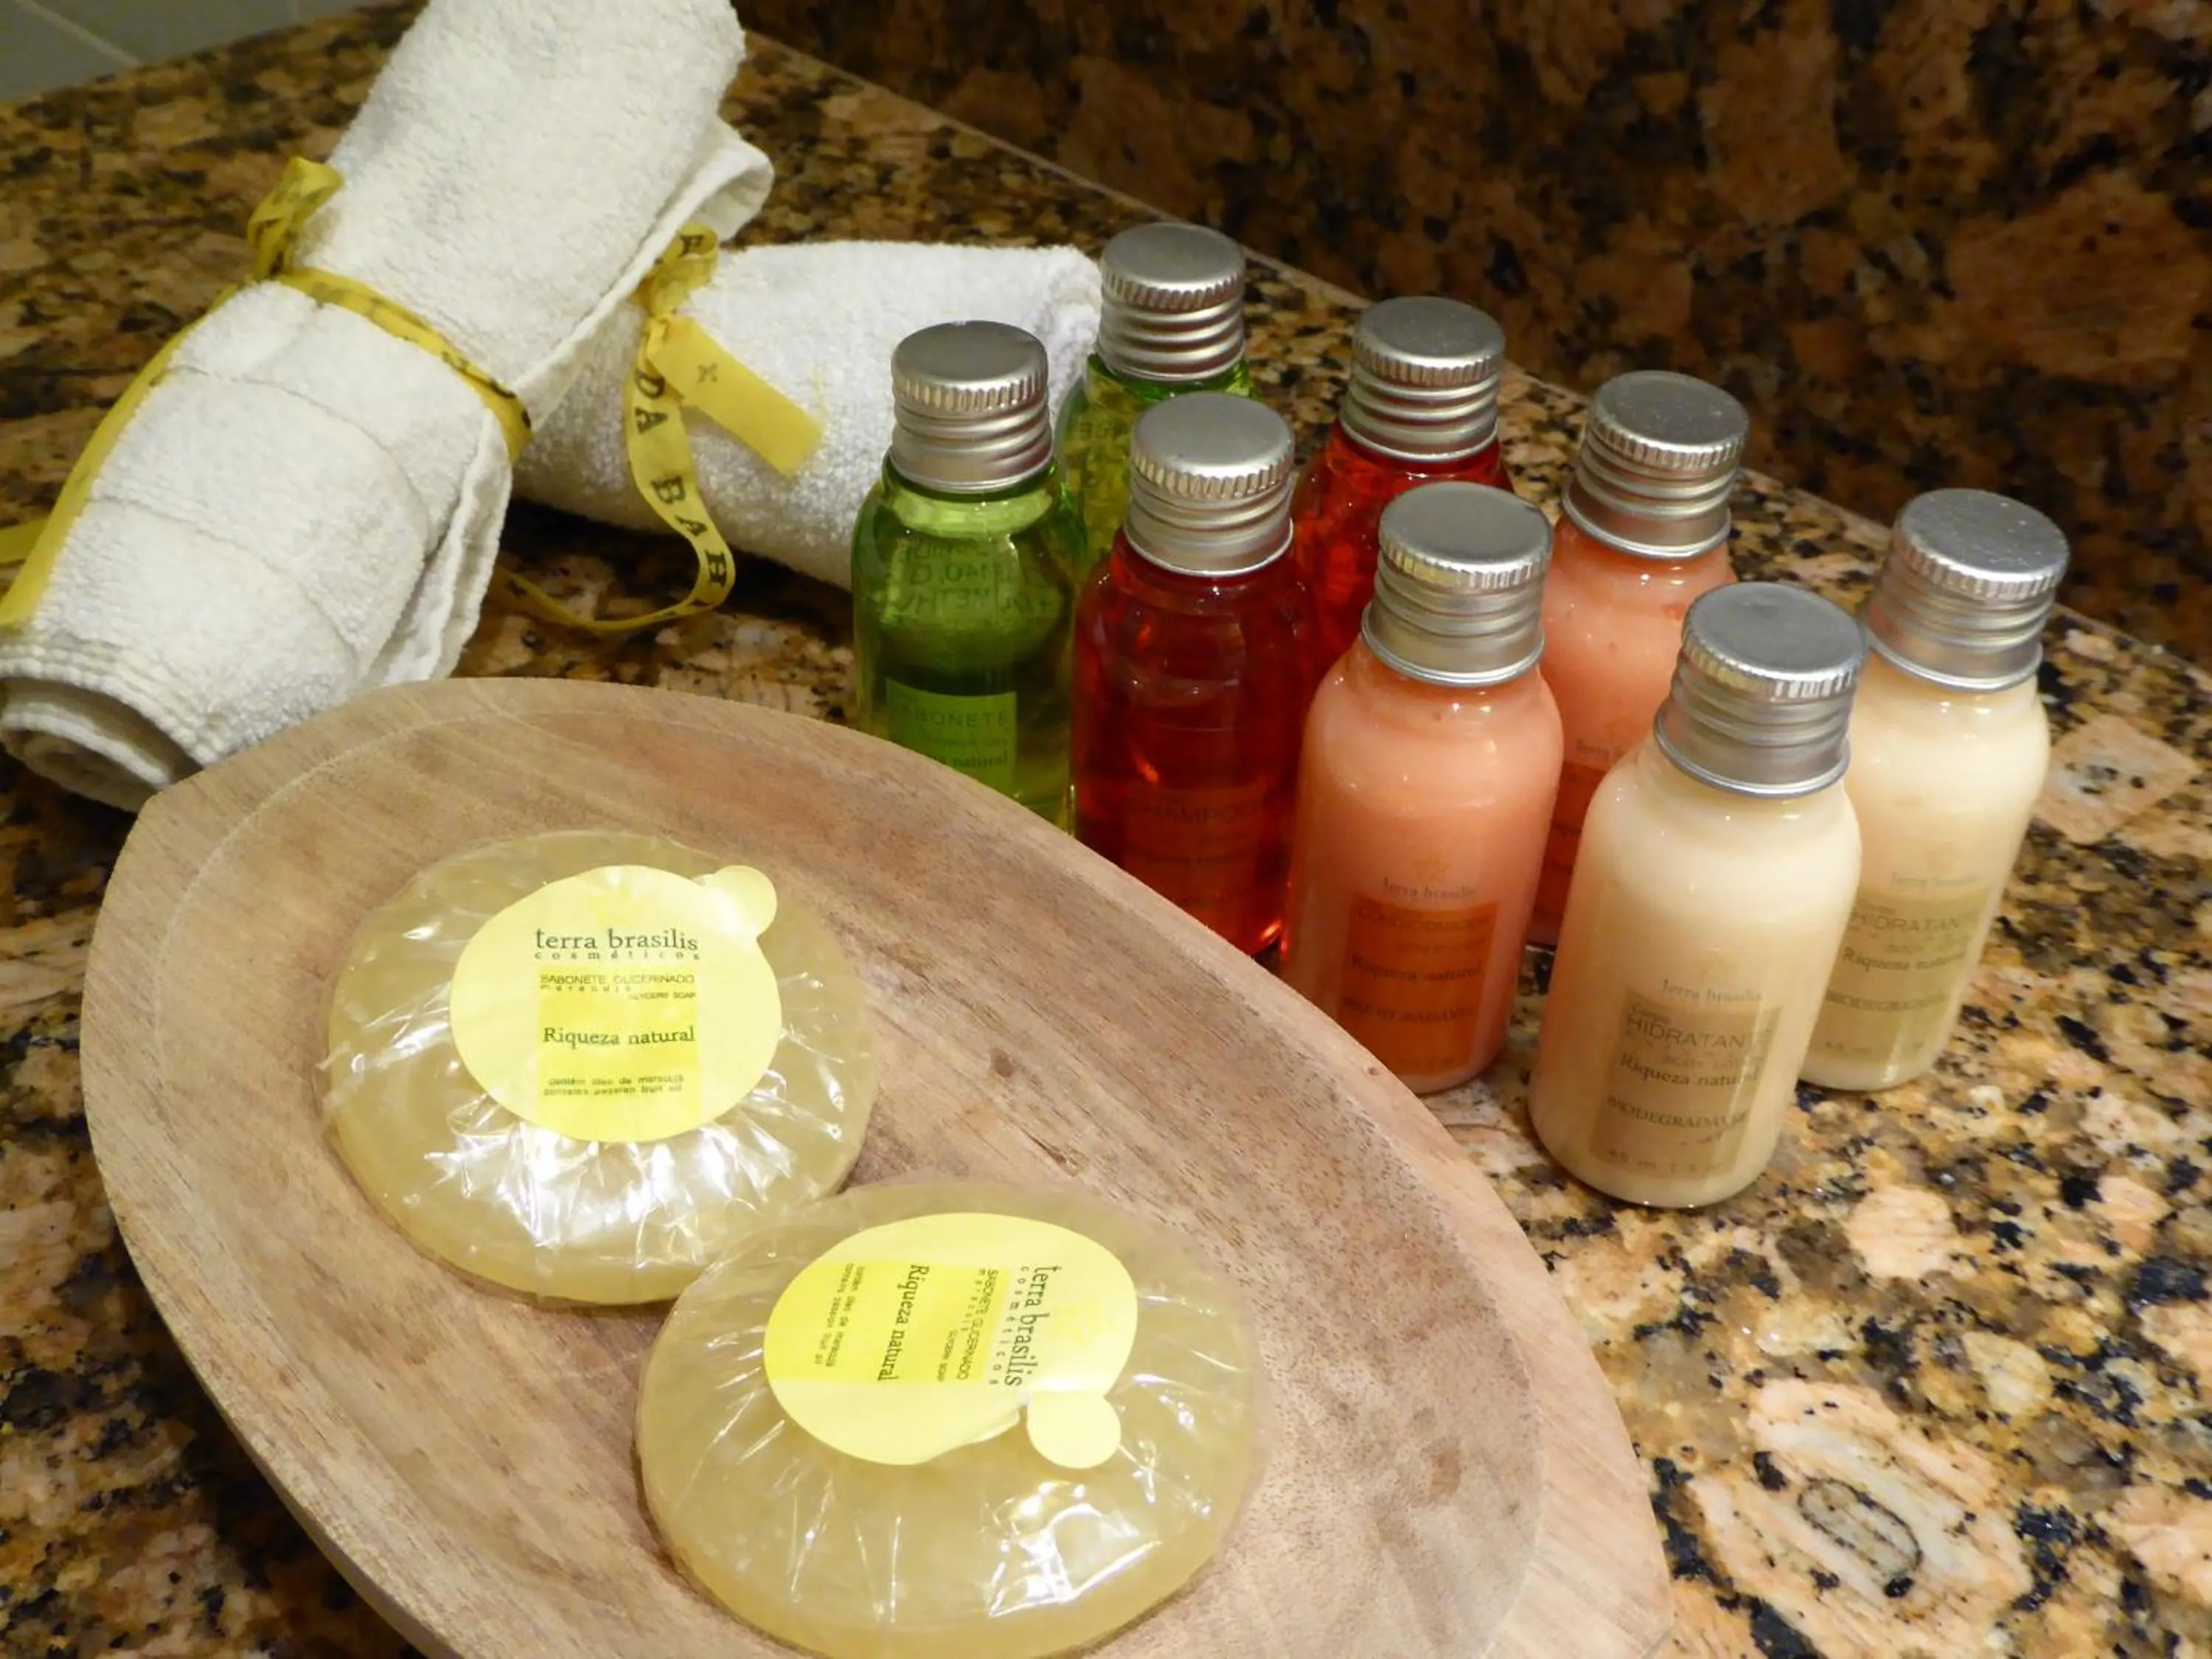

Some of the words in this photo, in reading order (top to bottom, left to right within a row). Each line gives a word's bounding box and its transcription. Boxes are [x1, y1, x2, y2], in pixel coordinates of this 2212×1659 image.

[535, 928, 598, 950] terra
[608, 927, 699, 951] brasilis
[540, 973, 607, 986] SABONETE
[613, 974, 695, 985] GLICERINADO
[543, 1026, 620, 1050] Riqueza
[627, 1025, 695, 1046] natural
[1627, 1017, 1771, 1048] HIDRATAN
[1621, 1054, 1690, 1087] Riqueza
[1697, 1066, 1759, 1087] natul
[895, 1263, 931, 1326] Riqueza
[1023, 1265, 1063, 1308] terra
[877, 1328, 906, 1382] natural
[1004, 1312, 1051, 1388] brasilis
